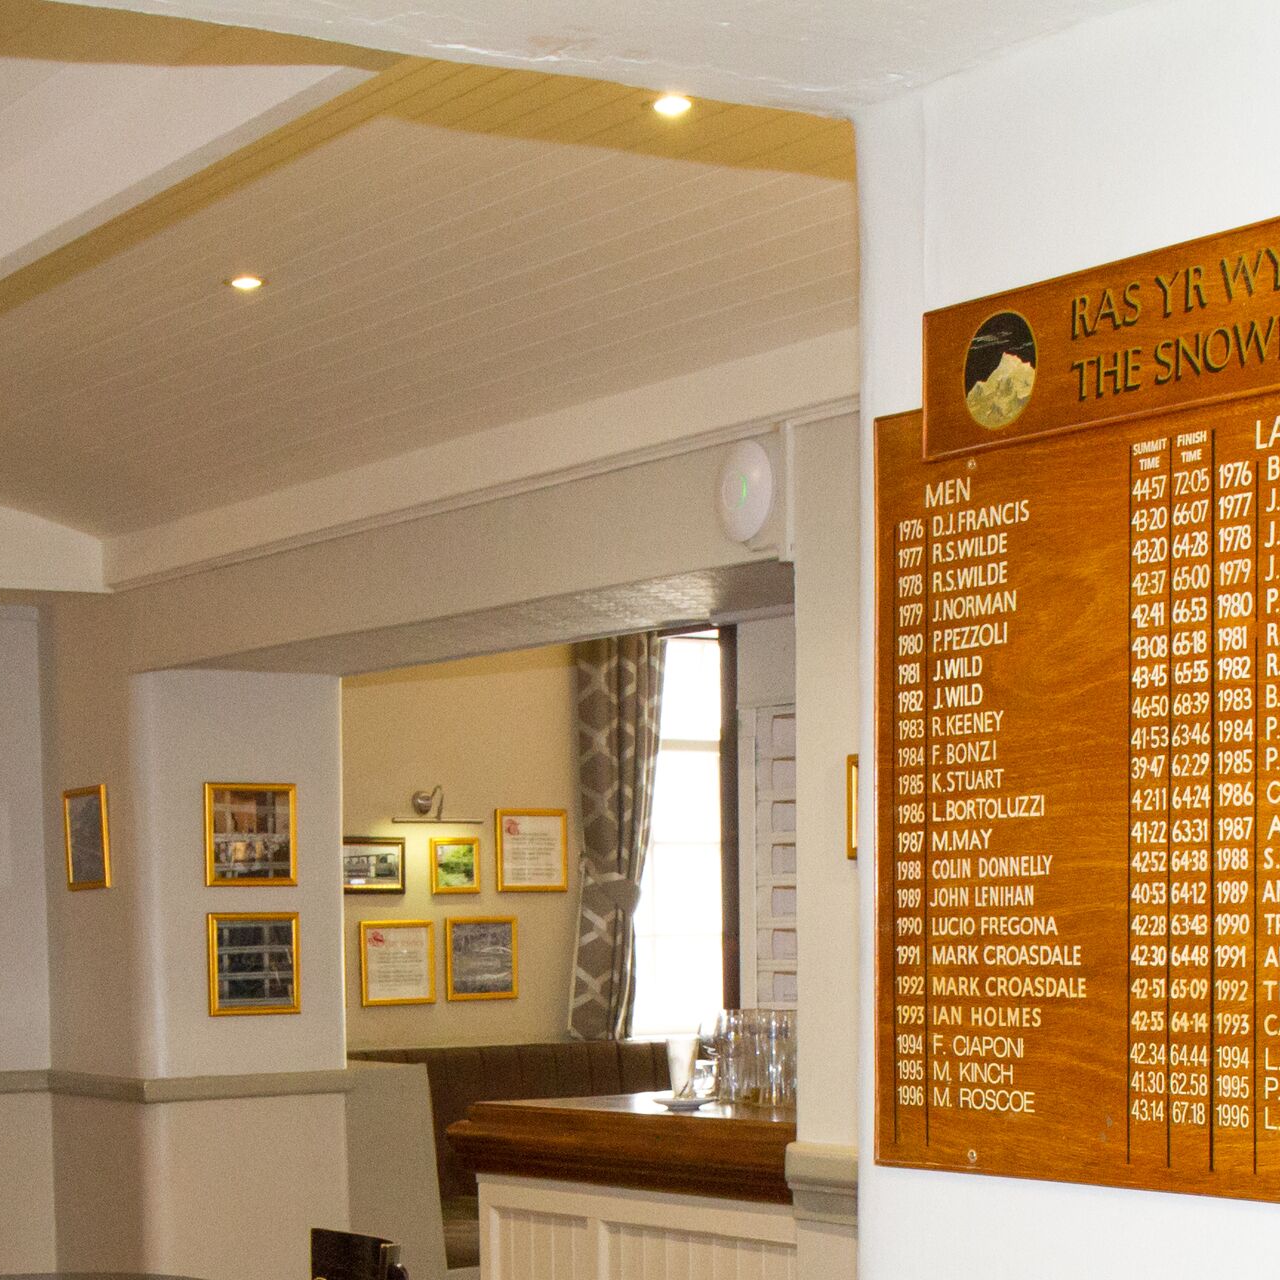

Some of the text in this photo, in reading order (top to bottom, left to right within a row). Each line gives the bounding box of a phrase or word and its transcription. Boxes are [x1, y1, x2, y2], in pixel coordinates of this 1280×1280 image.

[1071, 280, 1142, 341] RAS
[1154, 264, 1208, 319] YR
[1071, 346, 1143, 402] THE
[1132, 430, 1207, 457] SUMMIT FINISH
[1138, 448, 1202, 471] TIME TIME
[925, 476, 971, 509] MEN
[898, 519, 924, 542] 1976
[932, 589, 1017, 623] J.NORMAN
[933, 621, 1008, 653] P.PEZZOLI
[932, 655, 983, 682] J.WILD
[932, 709, 1005, 737] R.KEENEY
[931, 768, 1005, 793] K.STUART
[897, 794, 1045, 825] 1986 L.BORTOLUZZI
[931, 828, 993, 852] M.MAY
[931, 854, 1053, 880] COLIN DONNELLY
[929, 886, 969, 908] JOHN
[931, 915, 1059, 936] LUCIO FREGONA
[932, 944, 1082, 966] MARK CROASDALE
[932, 976, 1087, 999] MARK CROASDALE
[933, 1005, 1042, 1028] IAN HOLMES
[933, 1032, 1025, 1059] F. CIAPONI
[897, 1059, 1014, 1085] 1995 M. KINCH
[897, 1085, 1036, 1113] 1996 M. ROSCOE
[1263, 1076, 1279, 1100] P.
